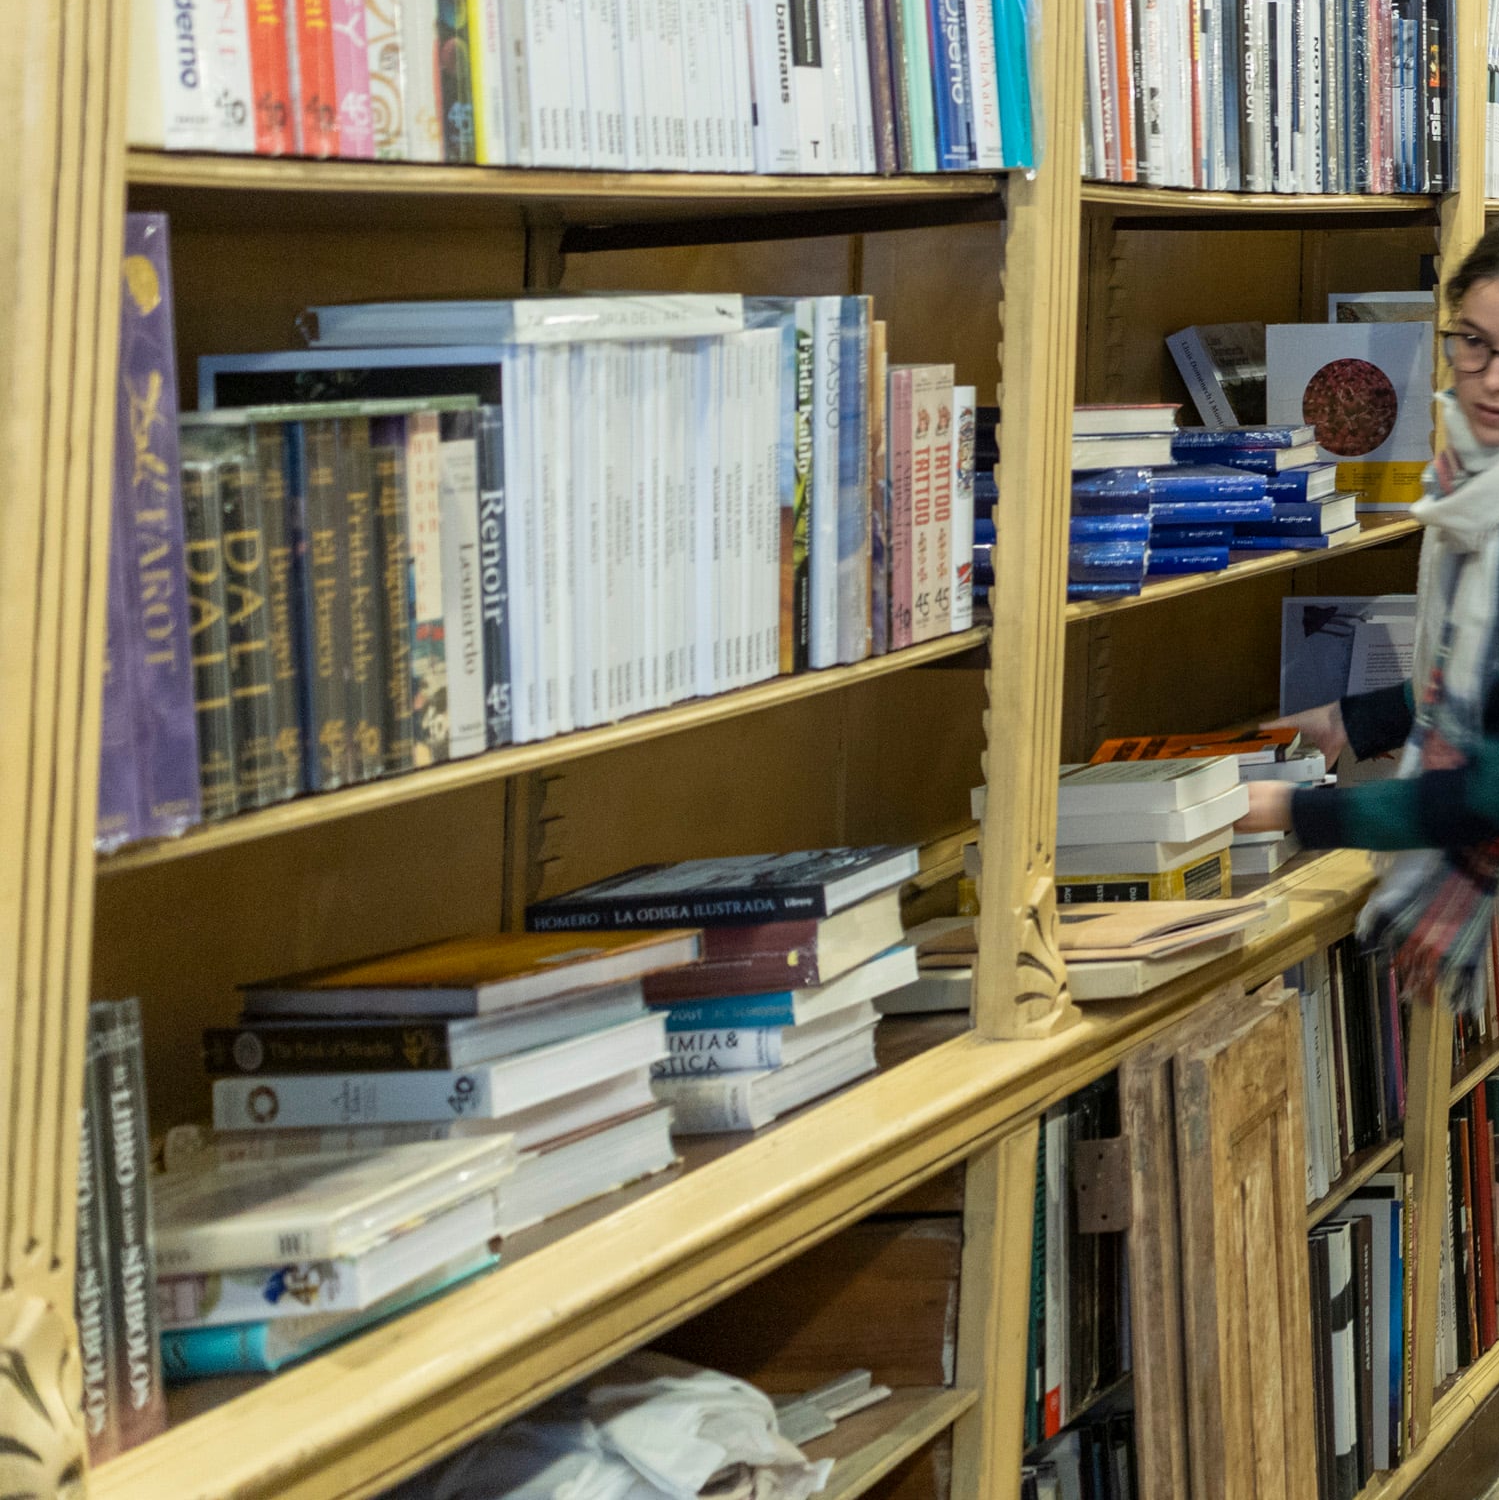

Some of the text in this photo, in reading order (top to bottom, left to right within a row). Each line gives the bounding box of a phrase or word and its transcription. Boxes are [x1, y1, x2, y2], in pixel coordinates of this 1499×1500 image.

[774, 2, 792, 105] bauhaus
[976, 42, 989, 58] de
[977, 61, 990, 75] la
[1098, 18, 1116, 144] Camera Work
[1244, 50, 1256, 123] GIBSON
[1327, 48, 1339, 130] Lindbergh
[982, 117, 994, 131] Z
[798, 336, 815, 475] Frida Kahlo
[825, 316, 842, 431] PICASSO
[914, 445, 932, 526] TATTOO
[934, 441, 951, 522] TATTOO
[135, 502, 179, 677] TAROT
[478, 489, 507, 625] Renoir
[457, 542, 480, 677] Leonardo
[534, 911, 599, 931] HOMERO
[614, 909, 632, 925] LA
[636, 905, 690, 922] ODISEA
[693, 899, 777, 917] ILUSTRADA
[725, 1031, 739, 1048] &
[110, 1087, 137, 1186] LIBRO
